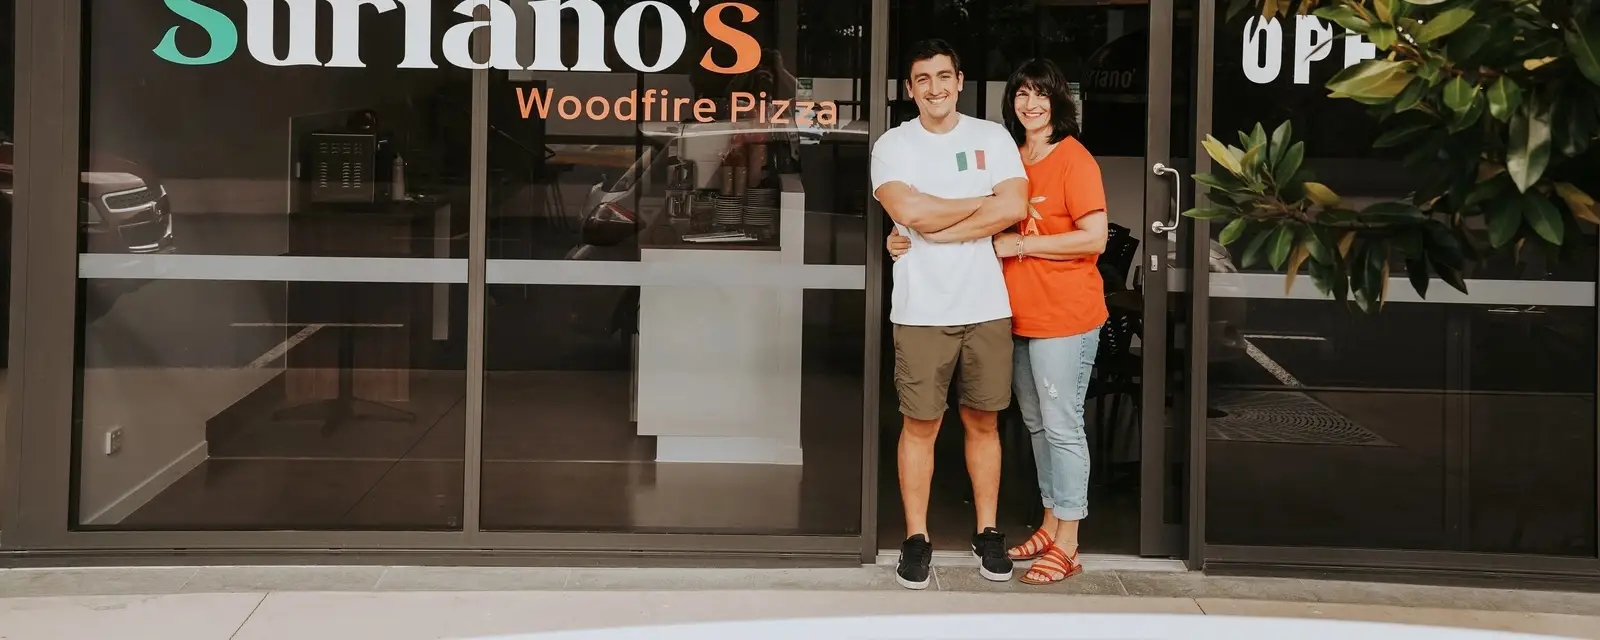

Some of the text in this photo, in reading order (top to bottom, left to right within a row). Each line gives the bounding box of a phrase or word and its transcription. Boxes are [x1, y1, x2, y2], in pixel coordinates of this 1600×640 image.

[152, 0, 762, 74] Suriano's
[515, 87, 838, 126] Woodfire Pizza
